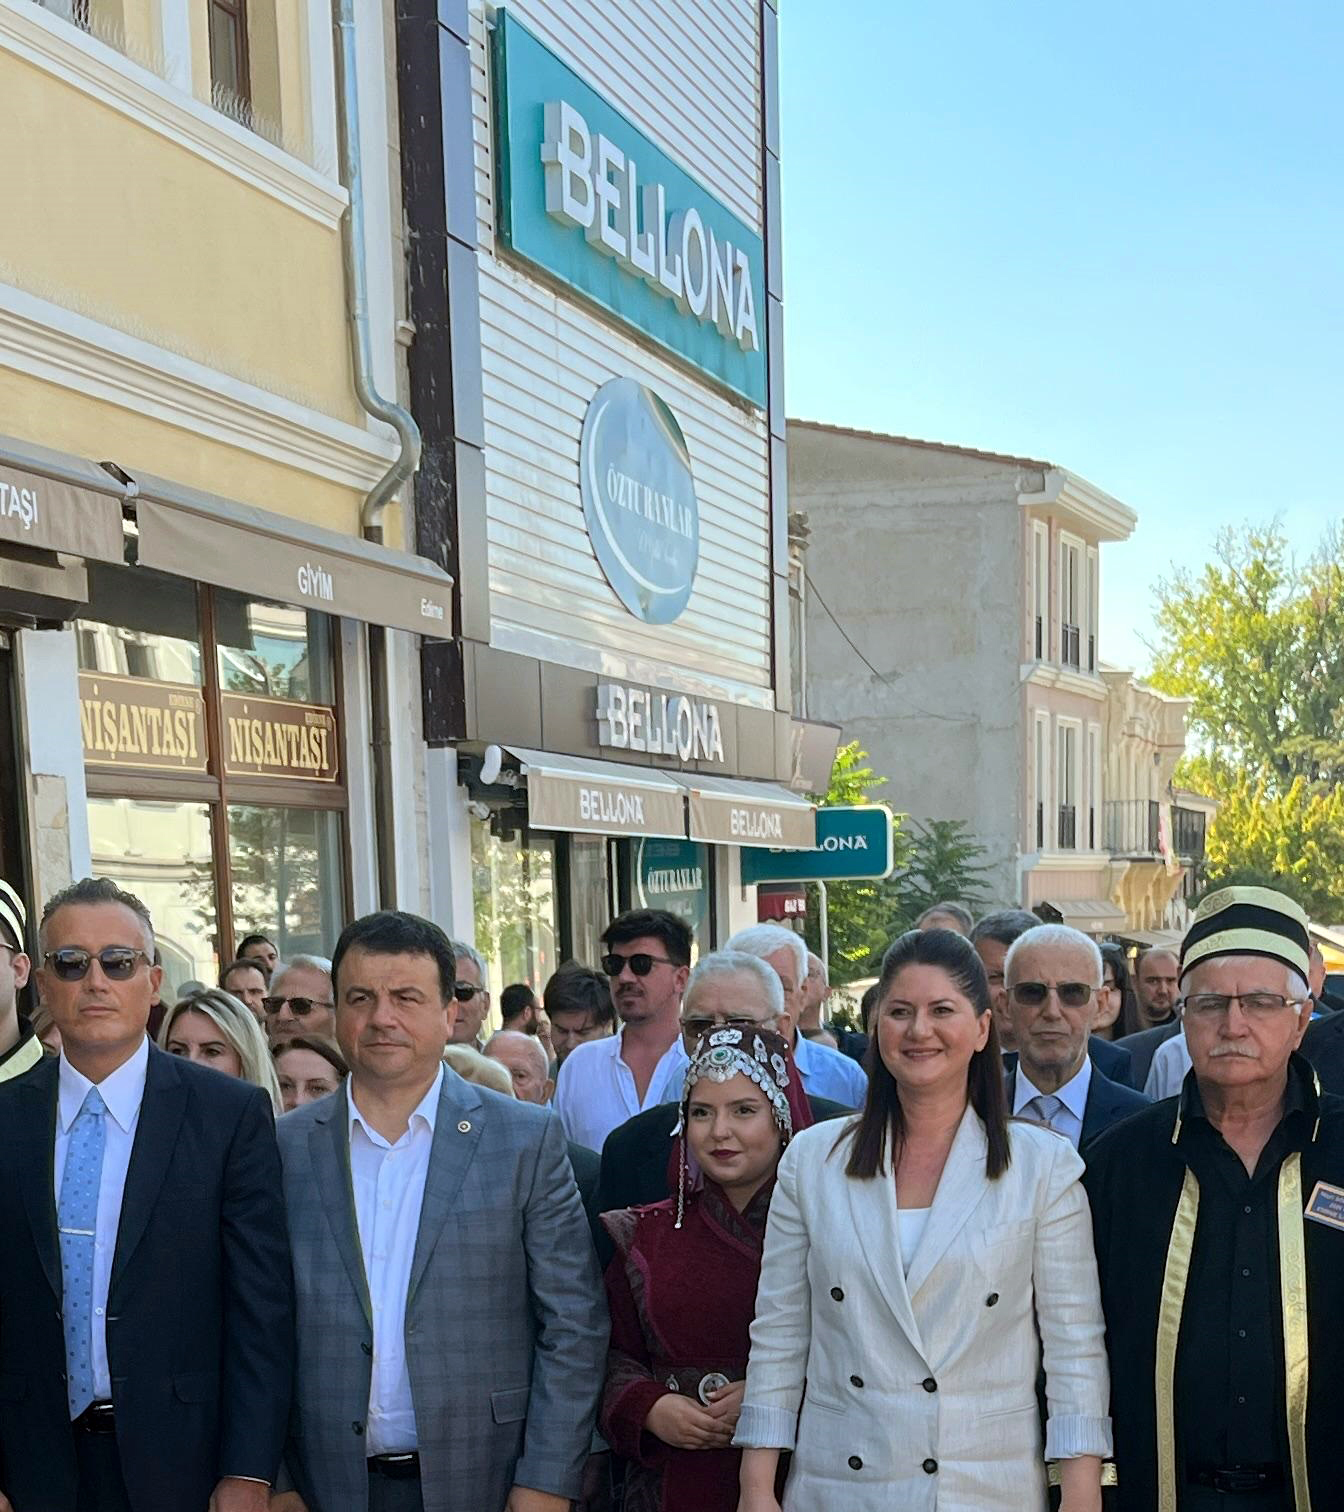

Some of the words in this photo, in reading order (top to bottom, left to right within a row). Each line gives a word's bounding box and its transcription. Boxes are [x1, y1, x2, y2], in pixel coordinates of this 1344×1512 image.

[543, 99, 760, 352] BELLONA
[297, 561, 334, 601] GİYİM
[79, 683, 198, 765] NİŞANTAŞI
[228, 704, 330, 776] NİŞANTAŞI
[598, 683, 725, 762] BELLONA
[579, 788, 645, 825] BELLONA
[730, 808, 783, 839] BELLONA
